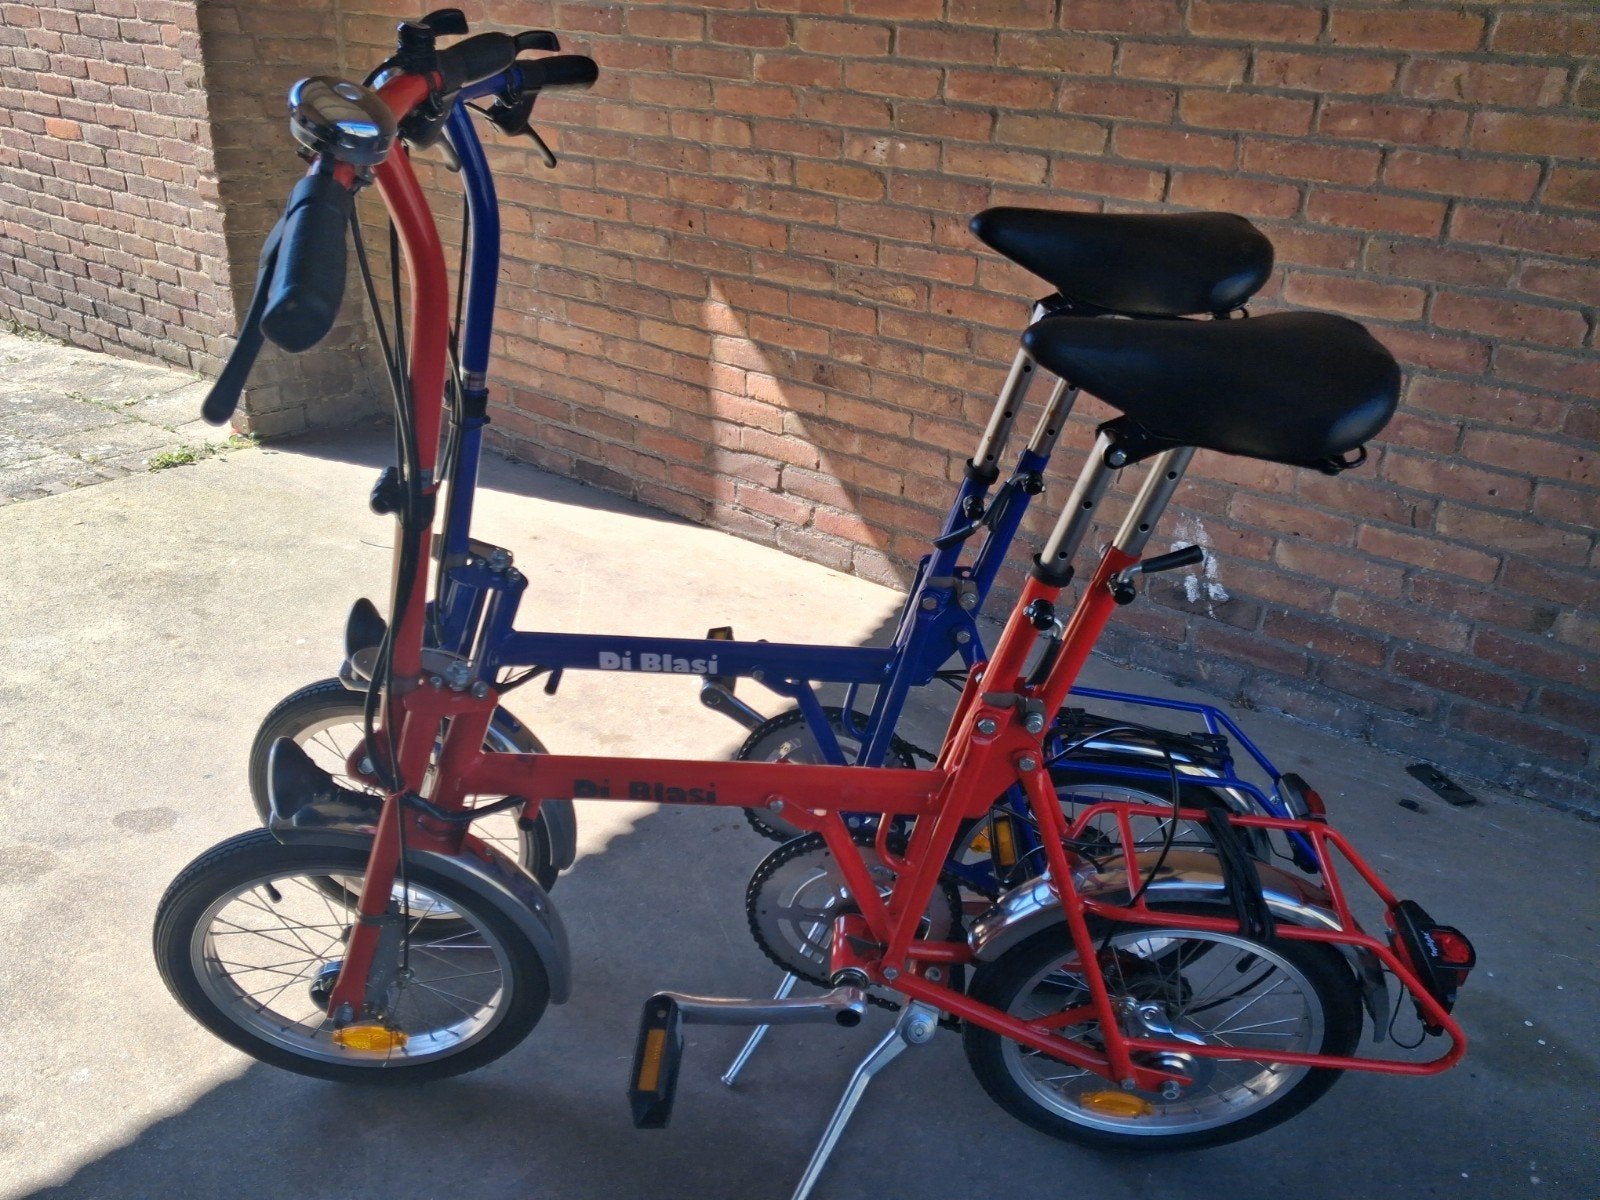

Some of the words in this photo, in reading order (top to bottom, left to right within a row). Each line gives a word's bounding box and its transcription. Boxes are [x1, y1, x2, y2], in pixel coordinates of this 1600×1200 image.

[598, 651, 632, 671] Di
[640, 653, 718, 675] Blasi
[573, 779, 611, 798] Di
[629, 781, 716, 803] Blasi
